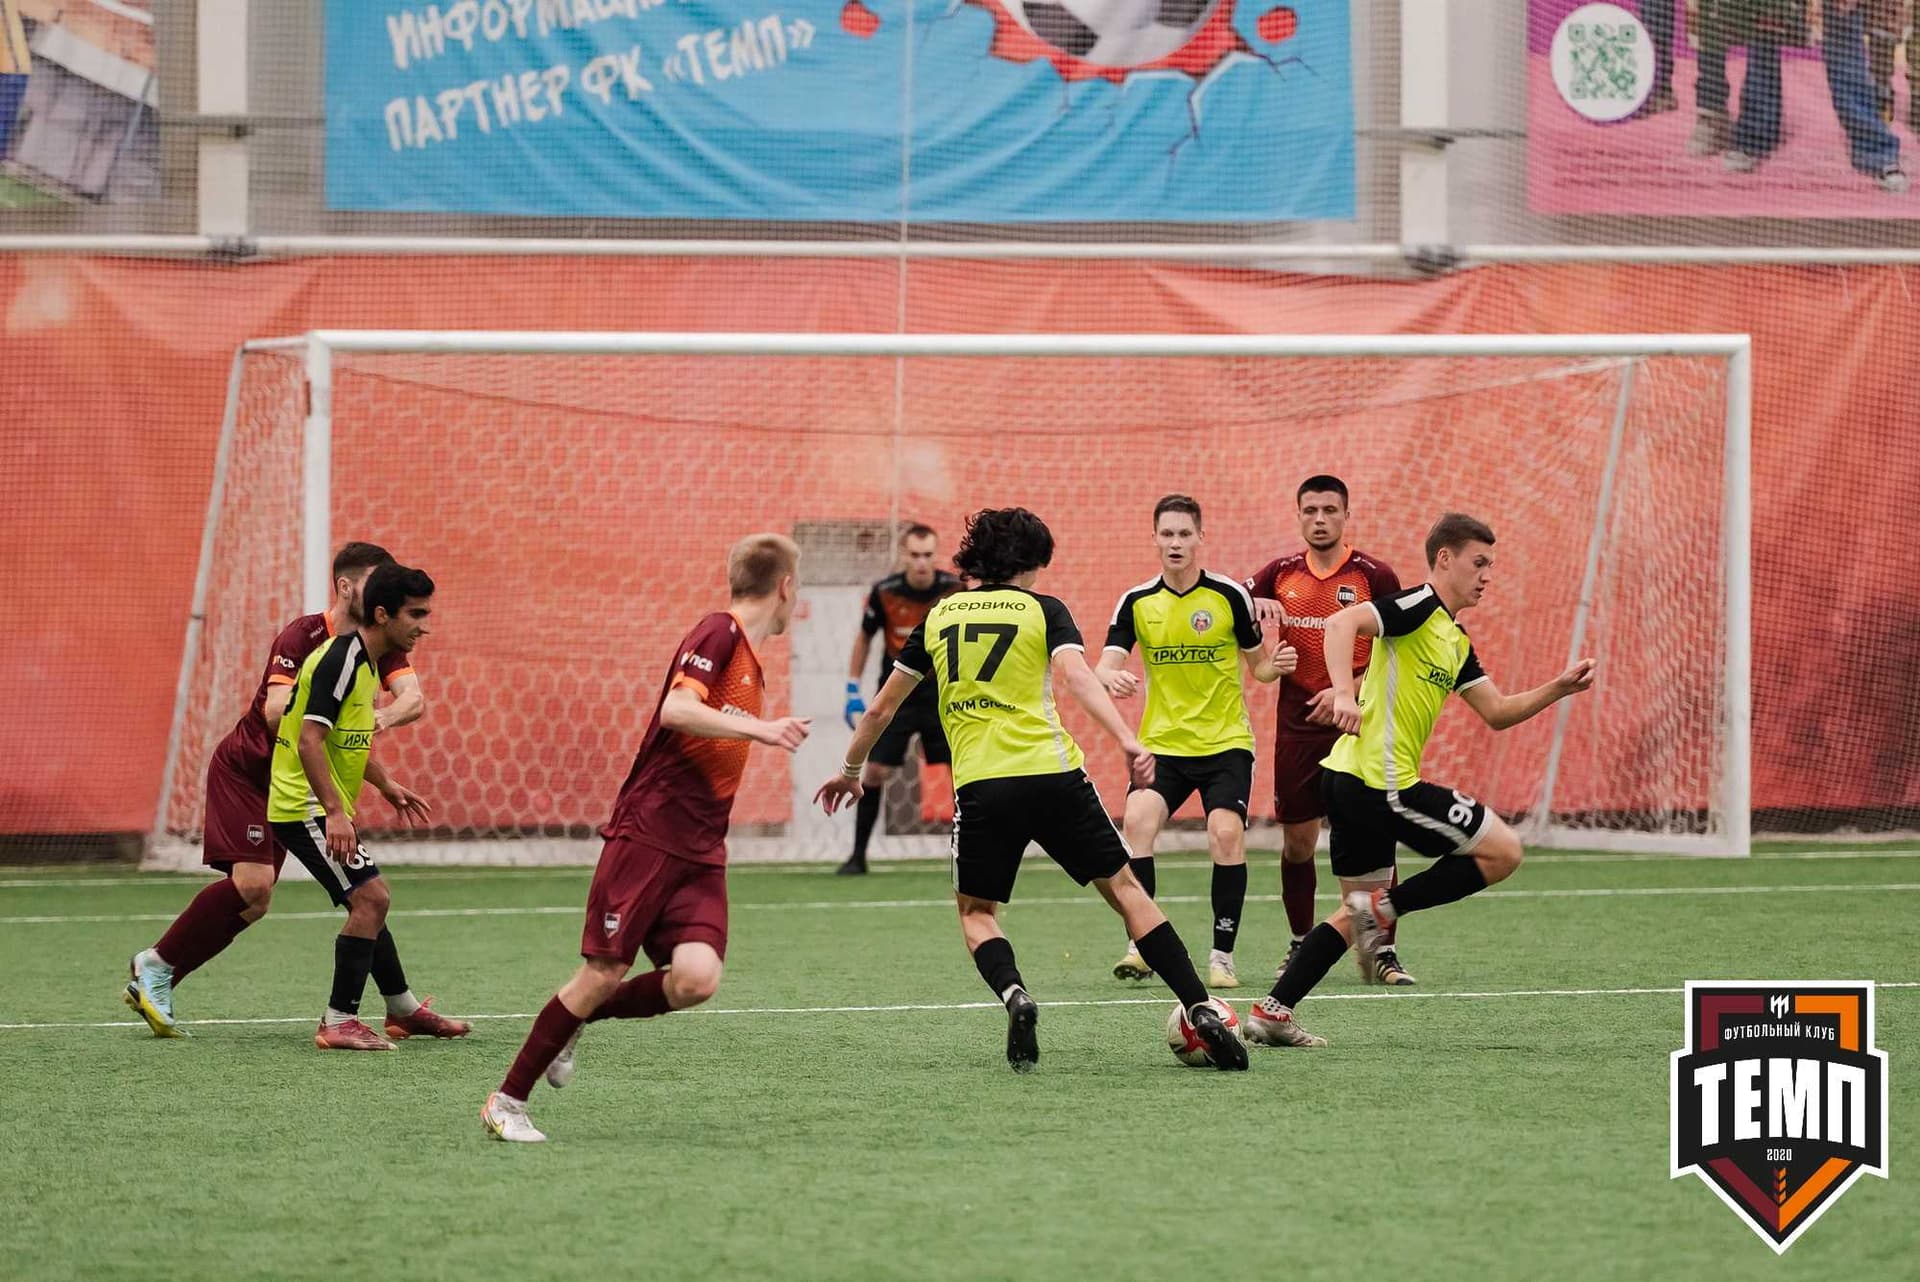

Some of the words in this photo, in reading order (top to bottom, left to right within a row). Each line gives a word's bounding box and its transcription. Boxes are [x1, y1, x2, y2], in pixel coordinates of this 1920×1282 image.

[385, 65, 570, 151] ПАРТНЕР
[581, 46, 654, 104] ФК
[663, 14, 817, 86] «ТЕМП»
[939, 623, 1019, 684] 17
